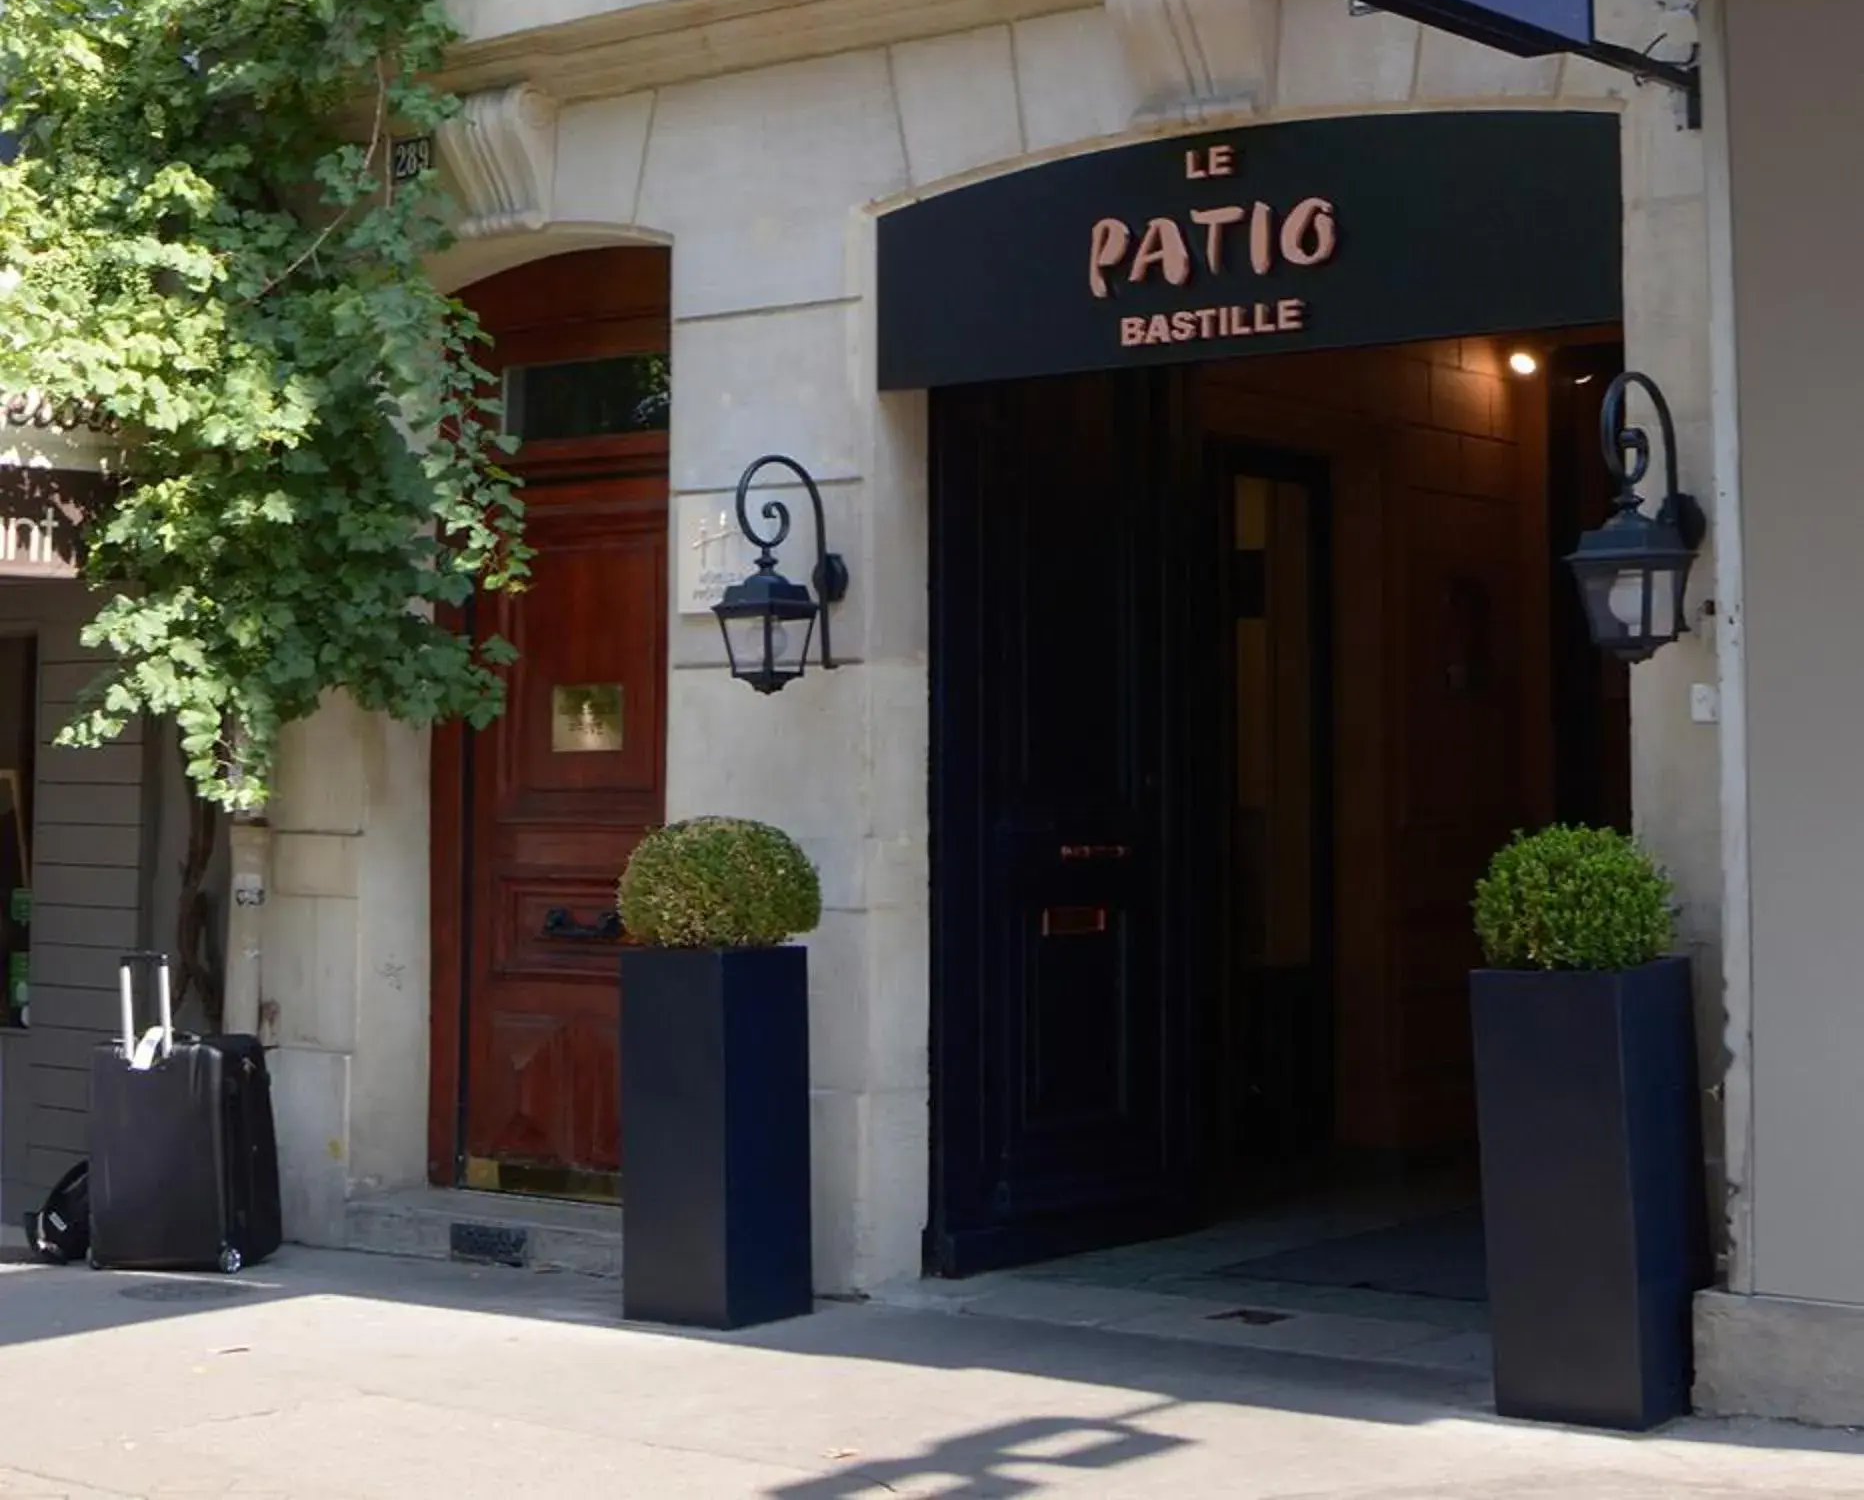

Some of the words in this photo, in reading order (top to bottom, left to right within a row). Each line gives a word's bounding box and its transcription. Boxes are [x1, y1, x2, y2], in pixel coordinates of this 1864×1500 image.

[396, 139, 430, 177] 289
[1185, 145, 1235, 180] LE
[1089, 197, 1337, 299] PATIO
[1120, 298, 1305, 348] BASTILLE
